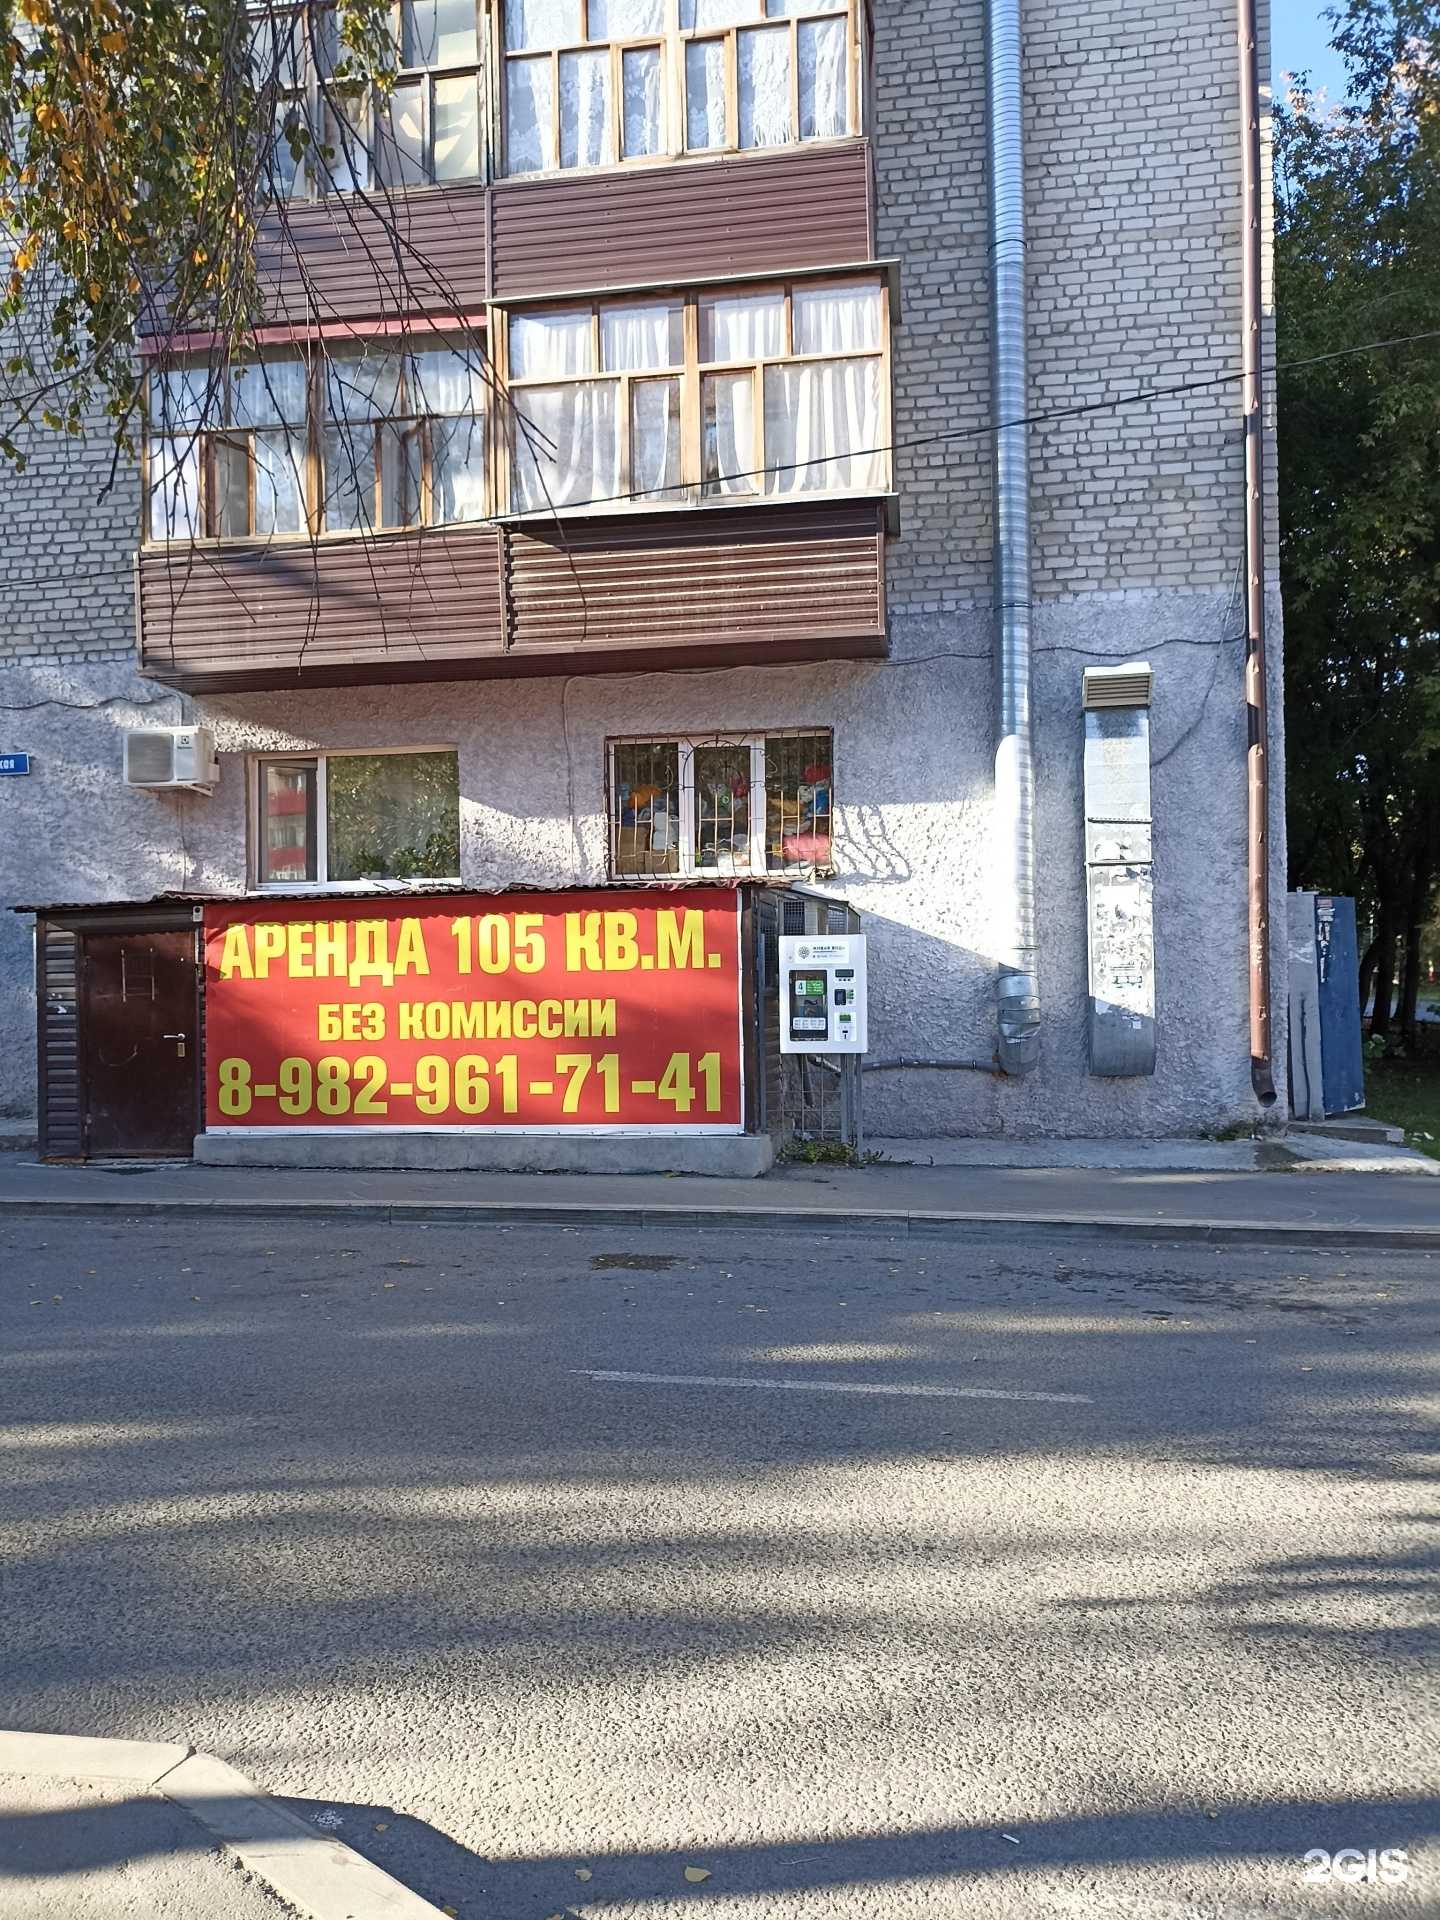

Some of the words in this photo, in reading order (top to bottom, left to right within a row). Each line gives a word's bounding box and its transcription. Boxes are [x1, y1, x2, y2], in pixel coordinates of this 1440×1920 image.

[219, 917, 431, 988] АРЕНДА
[451, 912, 547, 975] 105
[566, 909, 723, 973] КВ.М.
[317, 1003, 386, 1042] БЕЗ
[399, 998, 618, 1041] КОМИССИИ
[218, 1052, 723, 1116] 8-982-961-71-41
